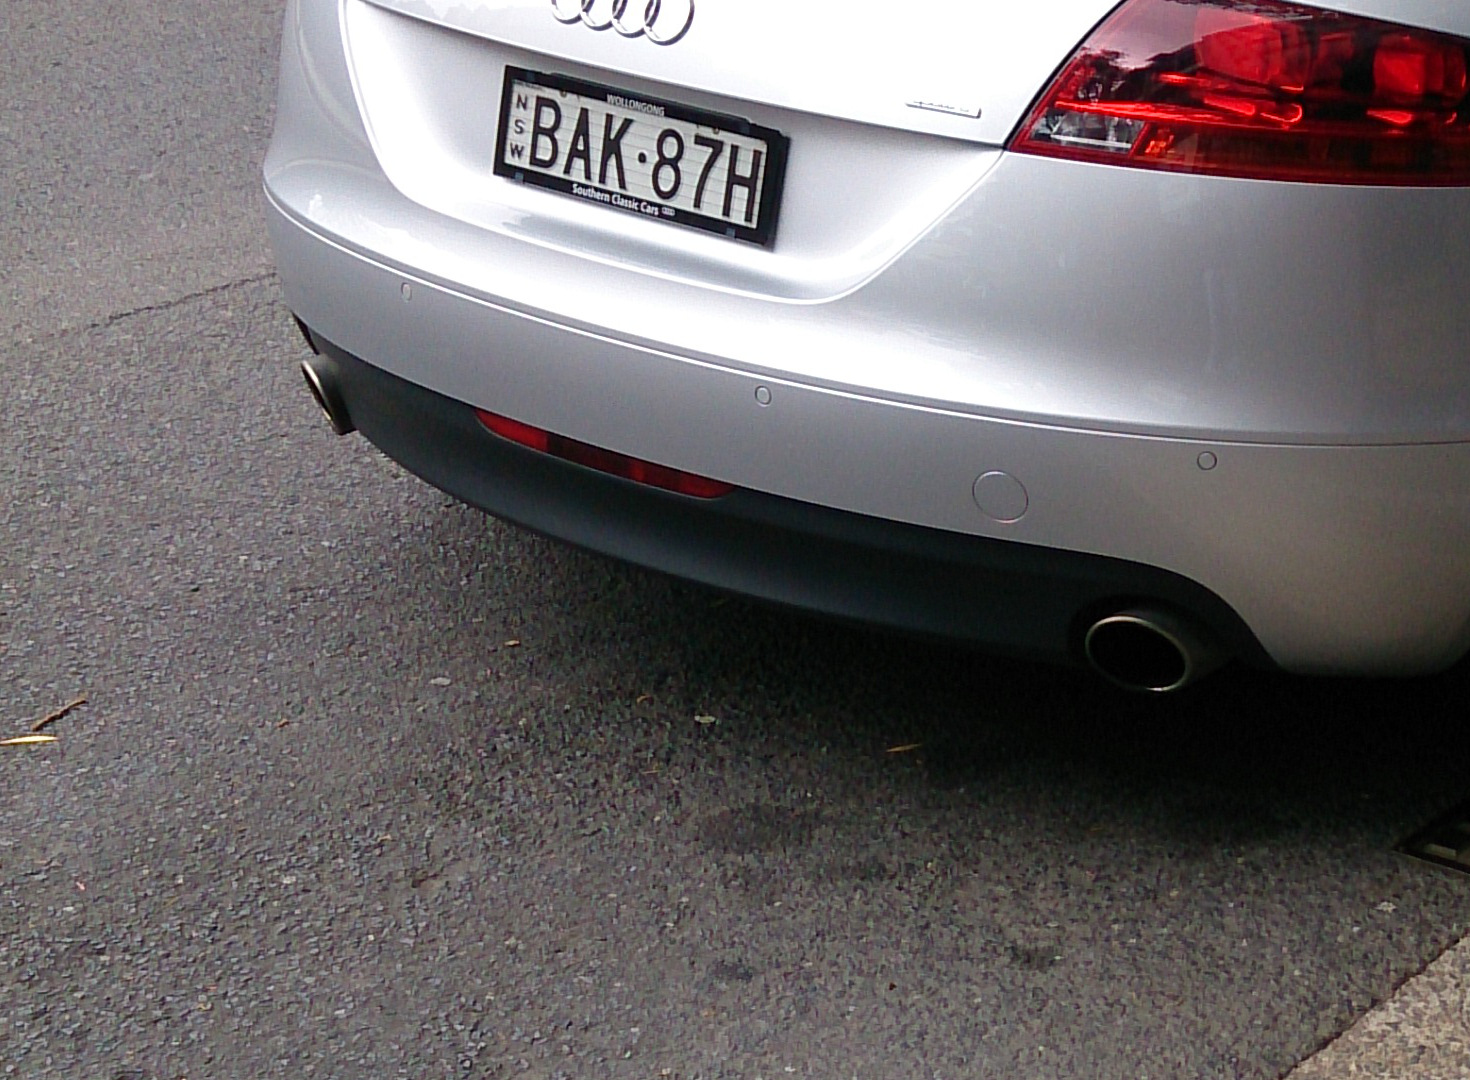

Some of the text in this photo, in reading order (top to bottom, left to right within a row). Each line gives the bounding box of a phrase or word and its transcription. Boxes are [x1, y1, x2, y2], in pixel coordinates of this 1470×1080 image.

[606, 94, 665, 117] WOLLONGONG
[572, 183, 660, 216] Southern Classic Cars
